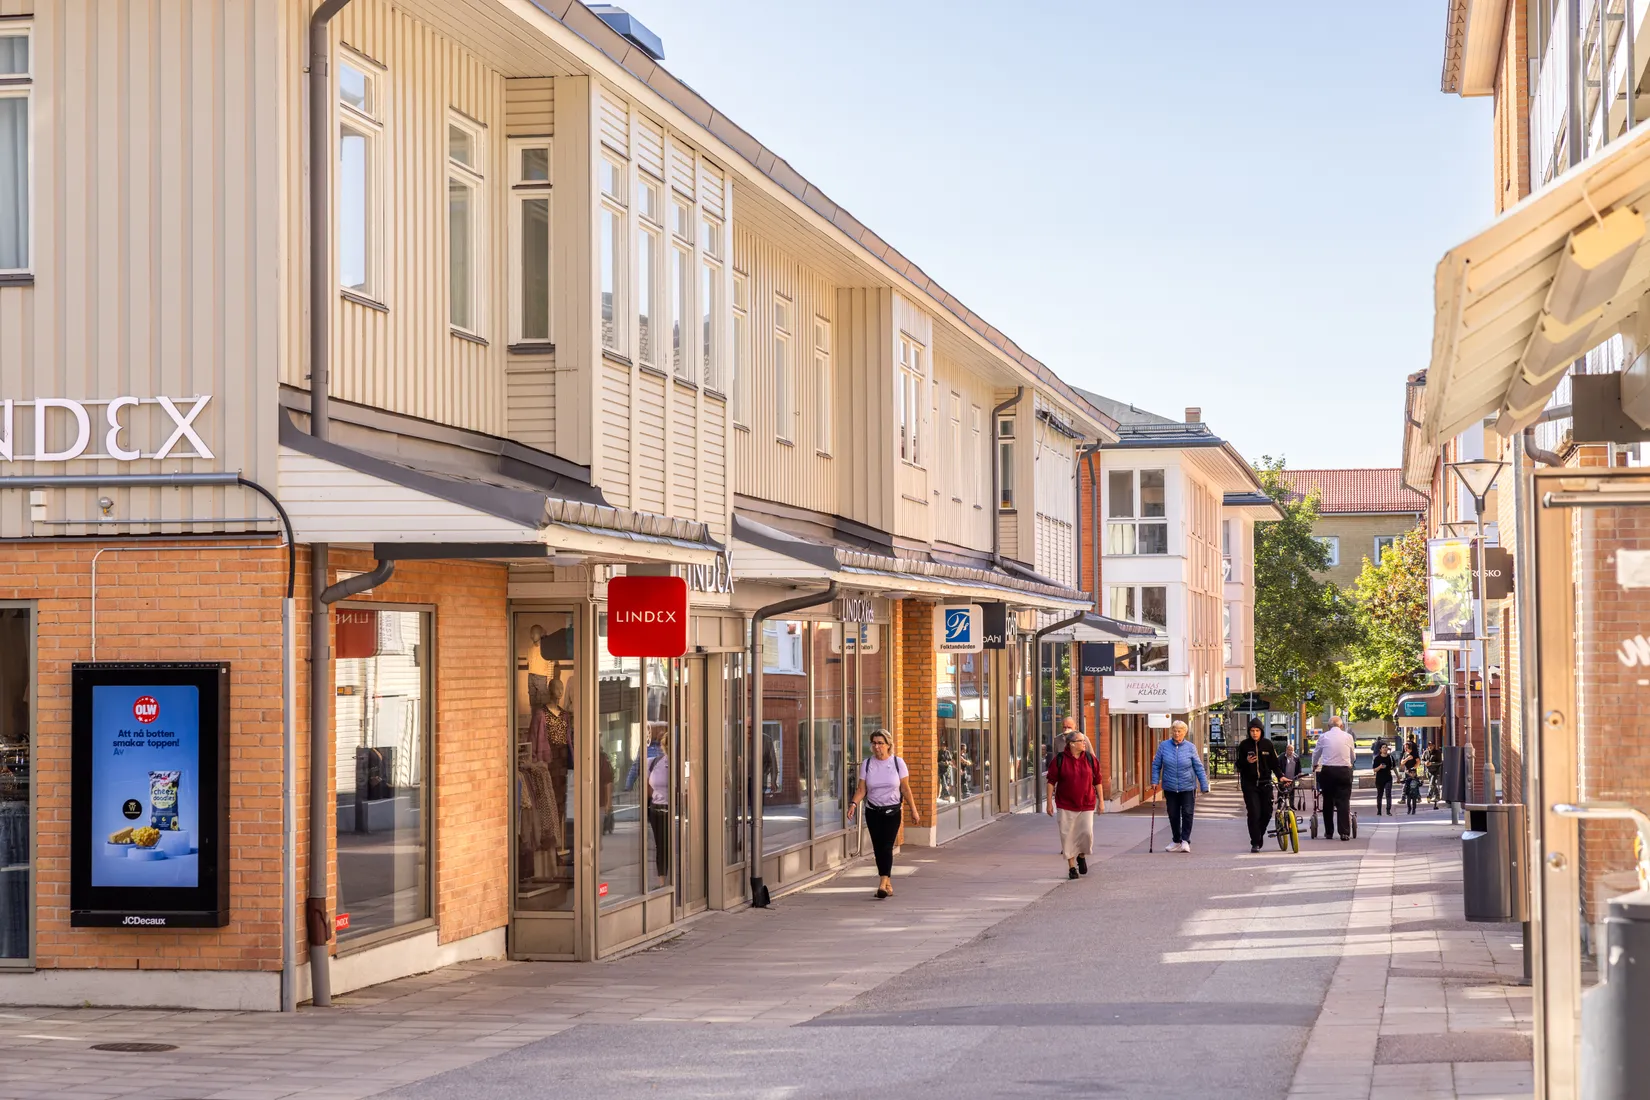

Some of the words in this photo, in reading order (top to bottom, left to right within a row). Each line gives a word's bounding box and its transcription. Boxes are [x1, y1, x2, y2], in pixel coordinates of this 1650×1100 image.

[616, 611, 677, 622] LINDEX
[135, 704, 157, 715] OLW
[118, 729, 132, 738] Att
[133, 729, 145, 738] nå
[146, 729, 175, 738] botten
[113, 739, 145, 747] smakar
[147, 738, 180, 749] toppen!
[113, 747, 124, 756] Av
[122, 916, 166, 925] JCDecaux
